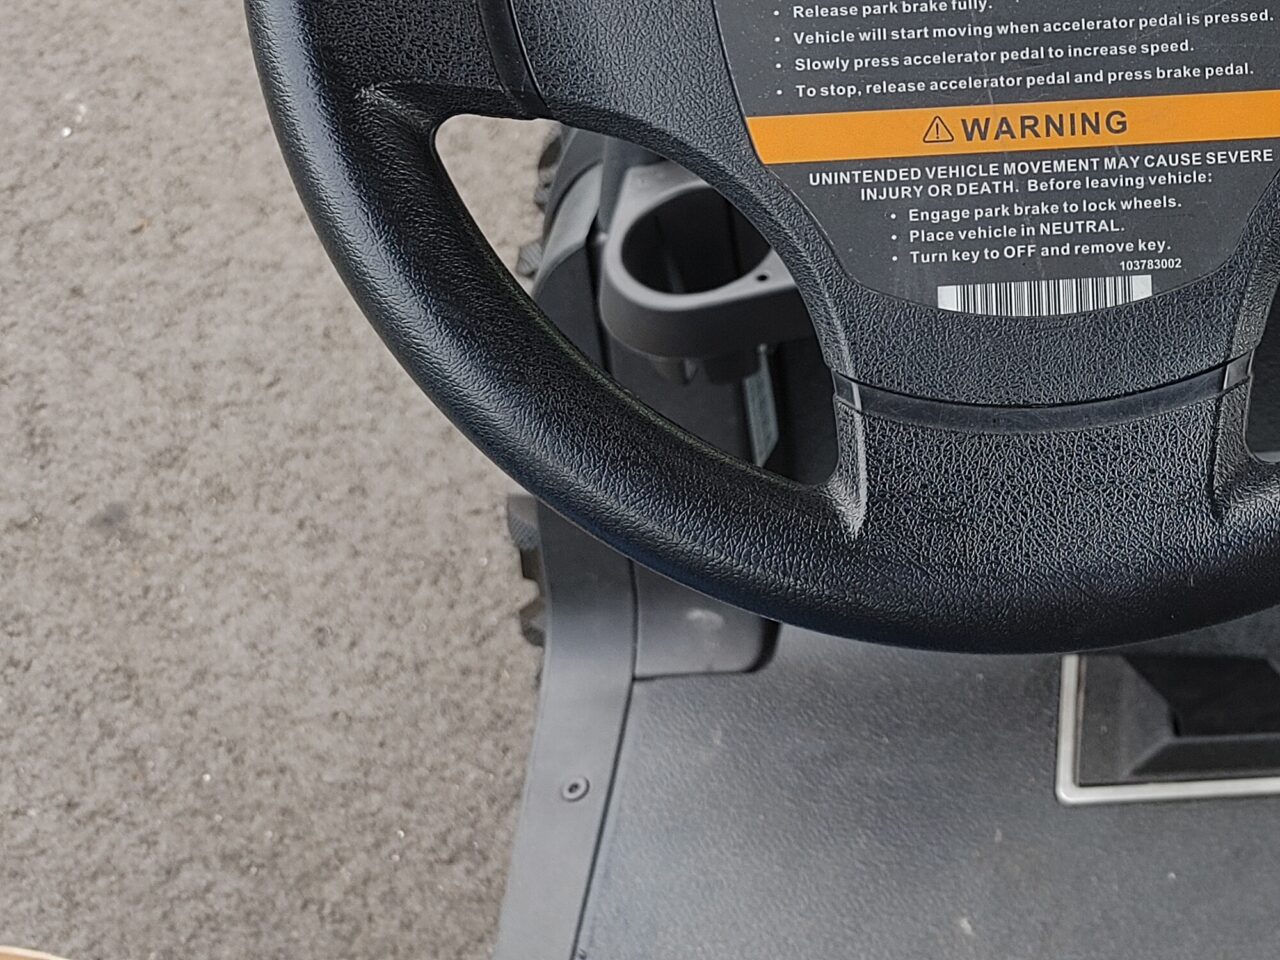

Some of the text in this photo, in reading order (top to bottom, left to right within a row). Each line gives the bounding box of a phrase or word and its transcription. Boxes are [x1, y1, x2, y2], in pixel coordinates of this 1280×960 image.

[793, 4, 858, 18] Release
[862, 1, 898, 18] park
[902, 0, 948, 13] brake
[793, 9, 1274, 45] Vehicle will start moving when accelerator pedal is pressed.
[795, 39, 1194, 72] Slowly press accelerator pedal to increase speed.
[795, 62, 1254, 98] To stop, release accelerator pedal and press brake pedal.
[961, 110, 1127, 142] WARNING
[809, 149, 1273, 186] UNINTENDED VEHICLE MOVEMENT MAY CAUSE SEVERE
[861, 170, 1212, 201] INJURY OR DEATH. Before leaving vehicle:
[908, 195, 1182, 224] Engage park brake to lock wheels.
[909, 219, 1125, 243] Place vehicle in NEUTRAL.
[909, 238, 1171, 264] Turn key to OFF and remove key.
[1119, 257, 1182, 271] 103783002
